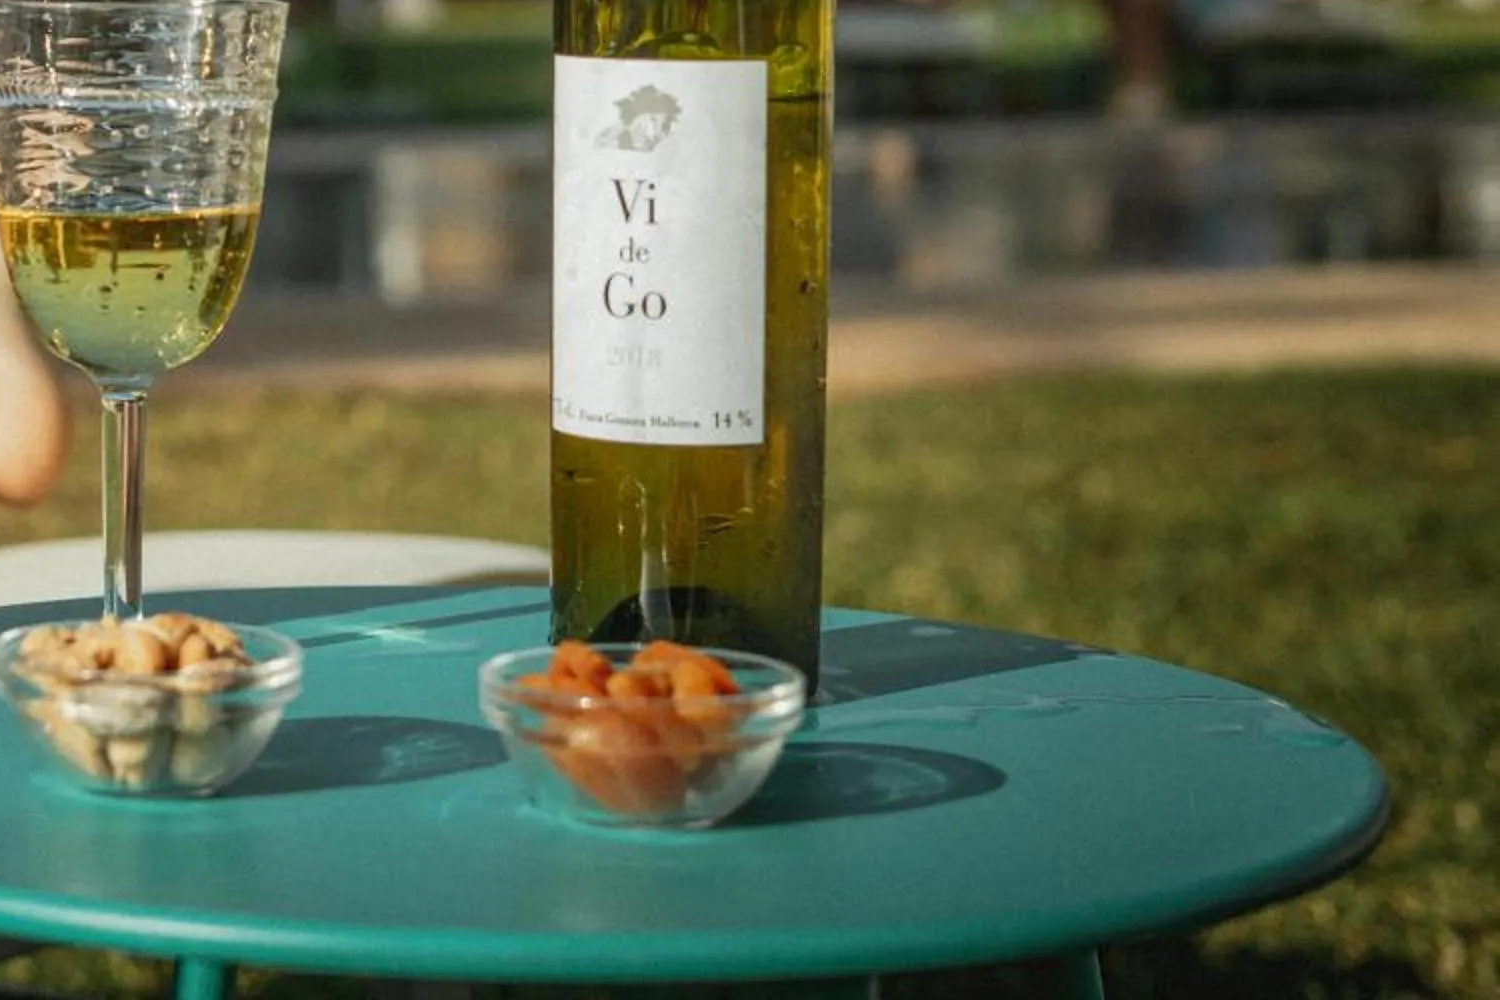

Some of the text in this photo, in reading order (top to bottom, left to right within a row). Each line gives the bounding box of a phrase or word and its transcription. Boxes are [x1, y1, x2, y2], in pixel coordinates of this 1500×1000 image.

[611, 178, 658, 225] Vi
[620, 236, 650, 264] de
[602, 272, 668, 319] Go
